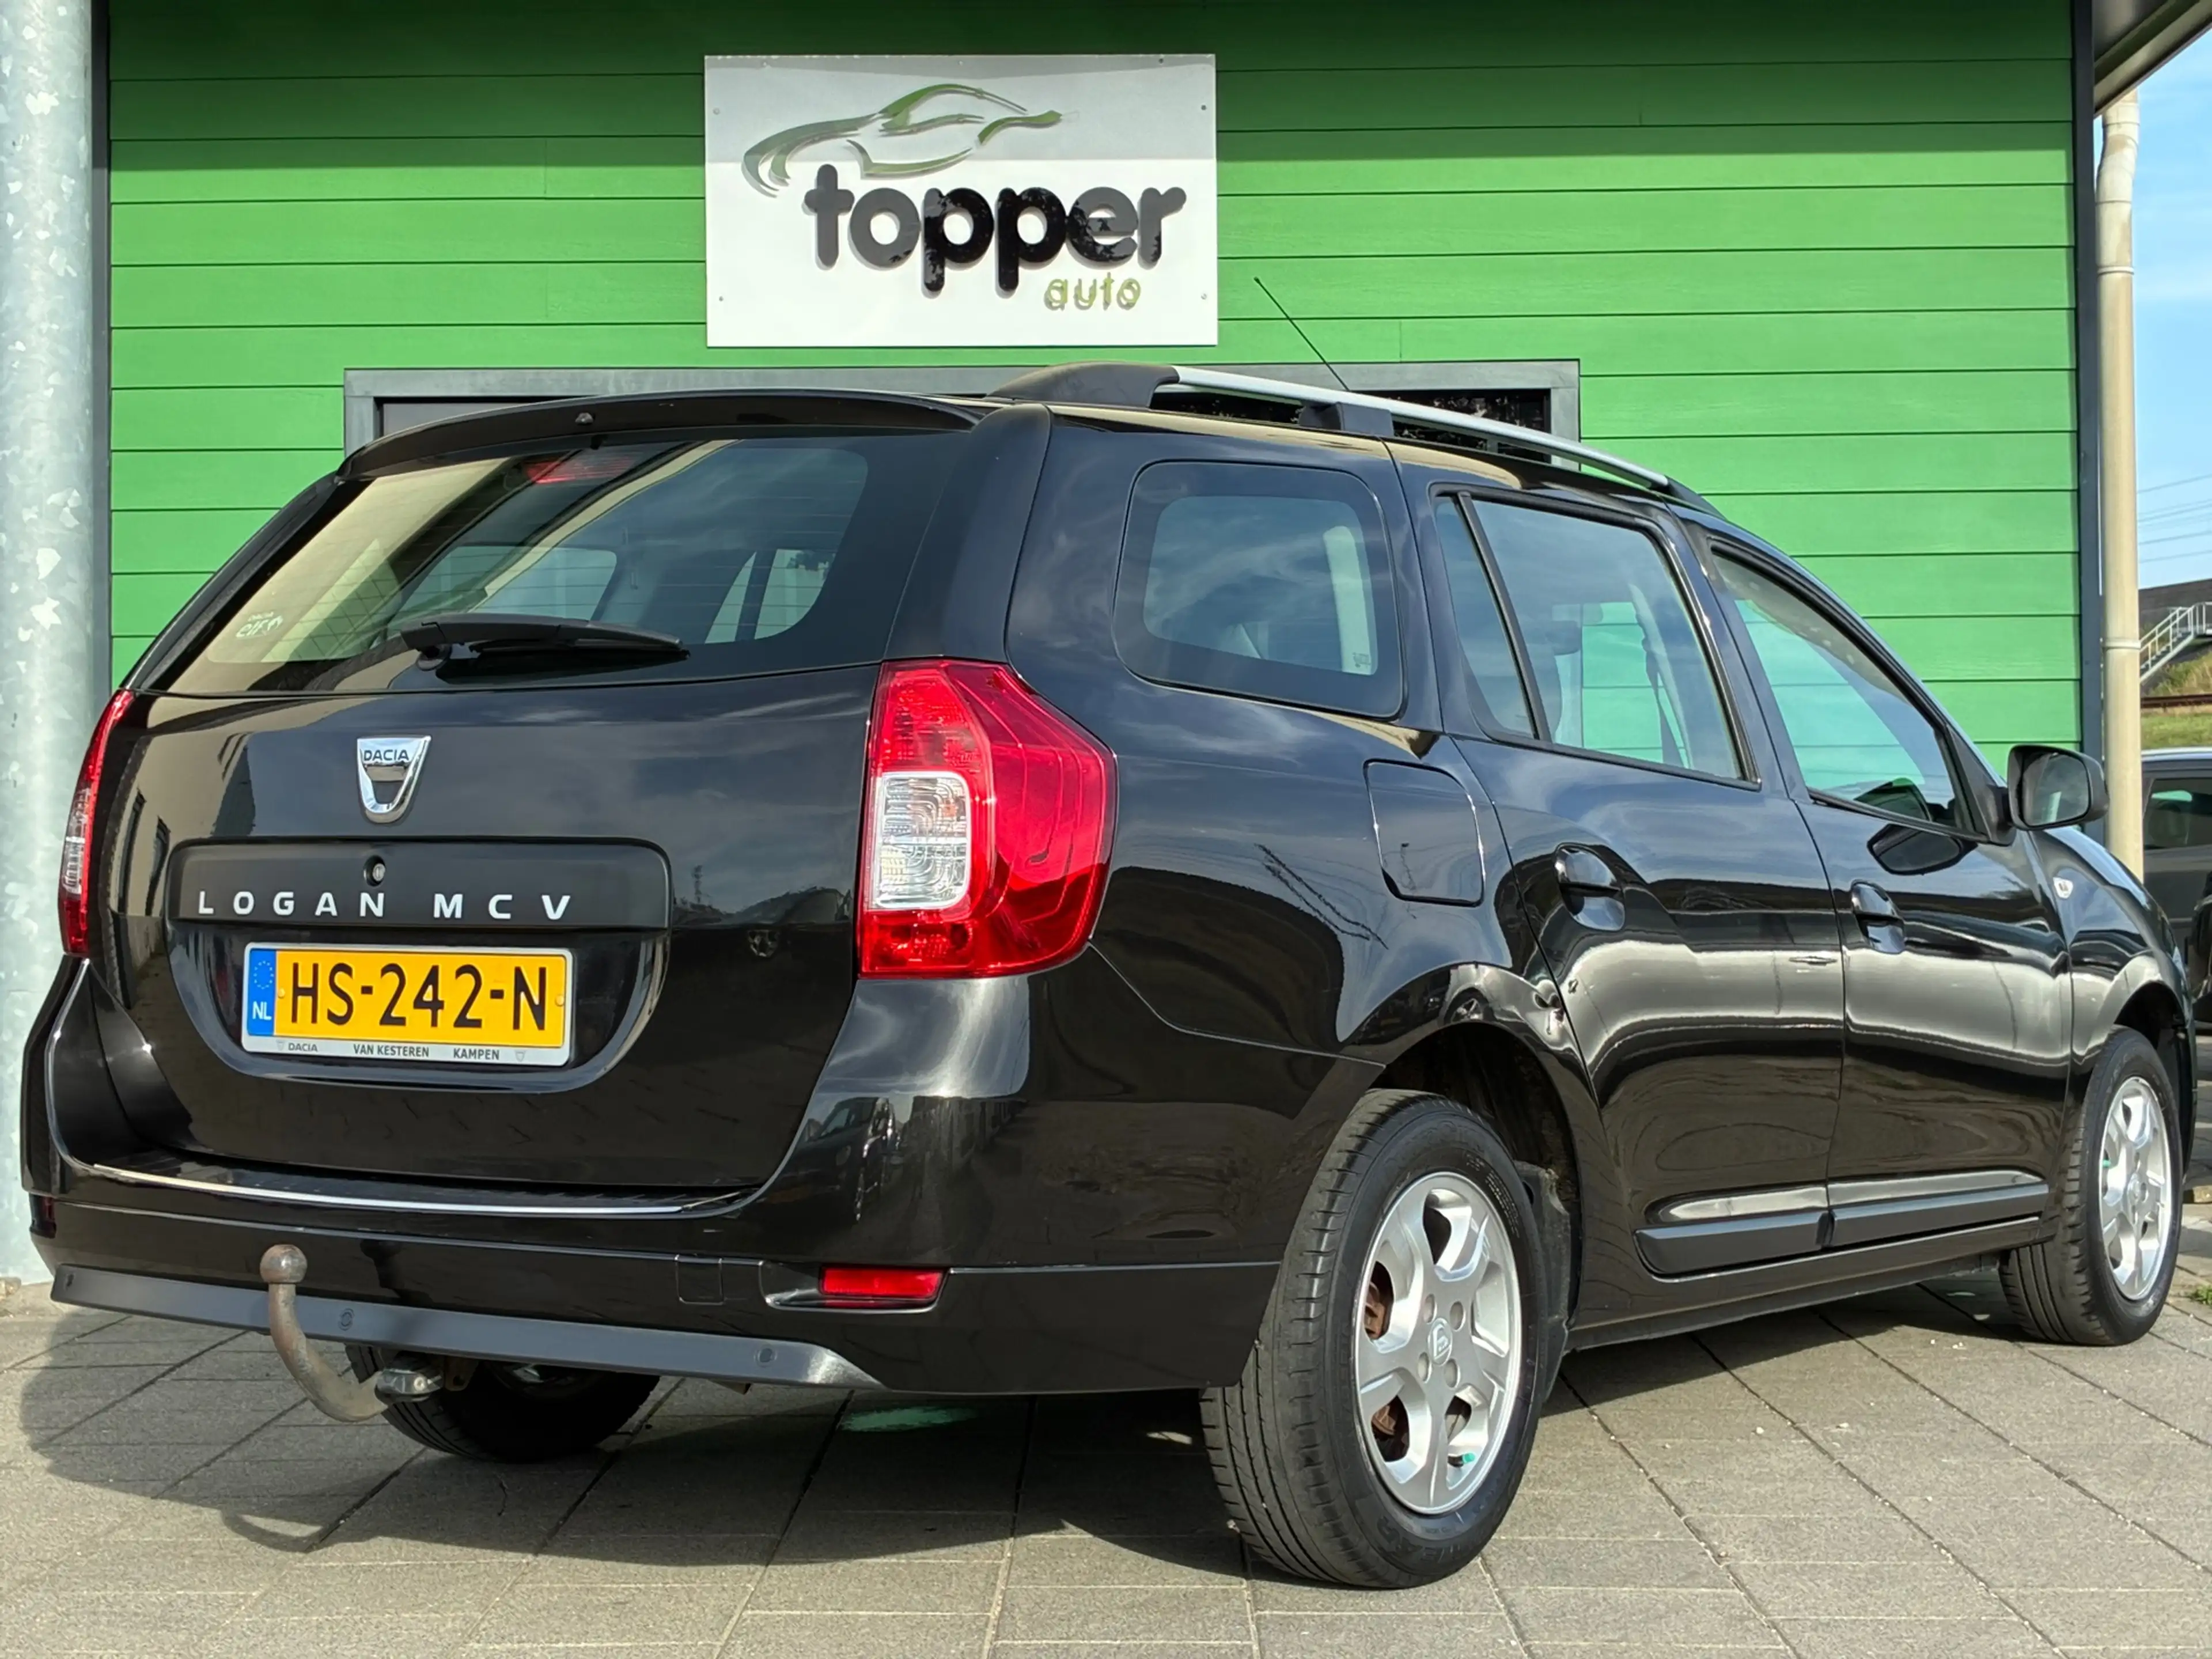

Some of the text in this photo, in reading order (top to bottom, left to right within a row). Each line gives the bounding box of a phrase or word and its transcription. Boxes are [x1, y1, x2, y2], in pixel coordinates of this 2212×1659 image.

[804, 164, 1187, 296] topper
[1044, 272, 1141, 309] auto
[363, 749, 410, 762] DACIA
[198, 891, 571, 921] LOGAN MCV
[252, 1001, 272, 1021] NL
[291, 961, 547, 1031] HS-242-N
[288, 1042, 500, 1060] DACIA VAN KESTEREN KAMPEN
